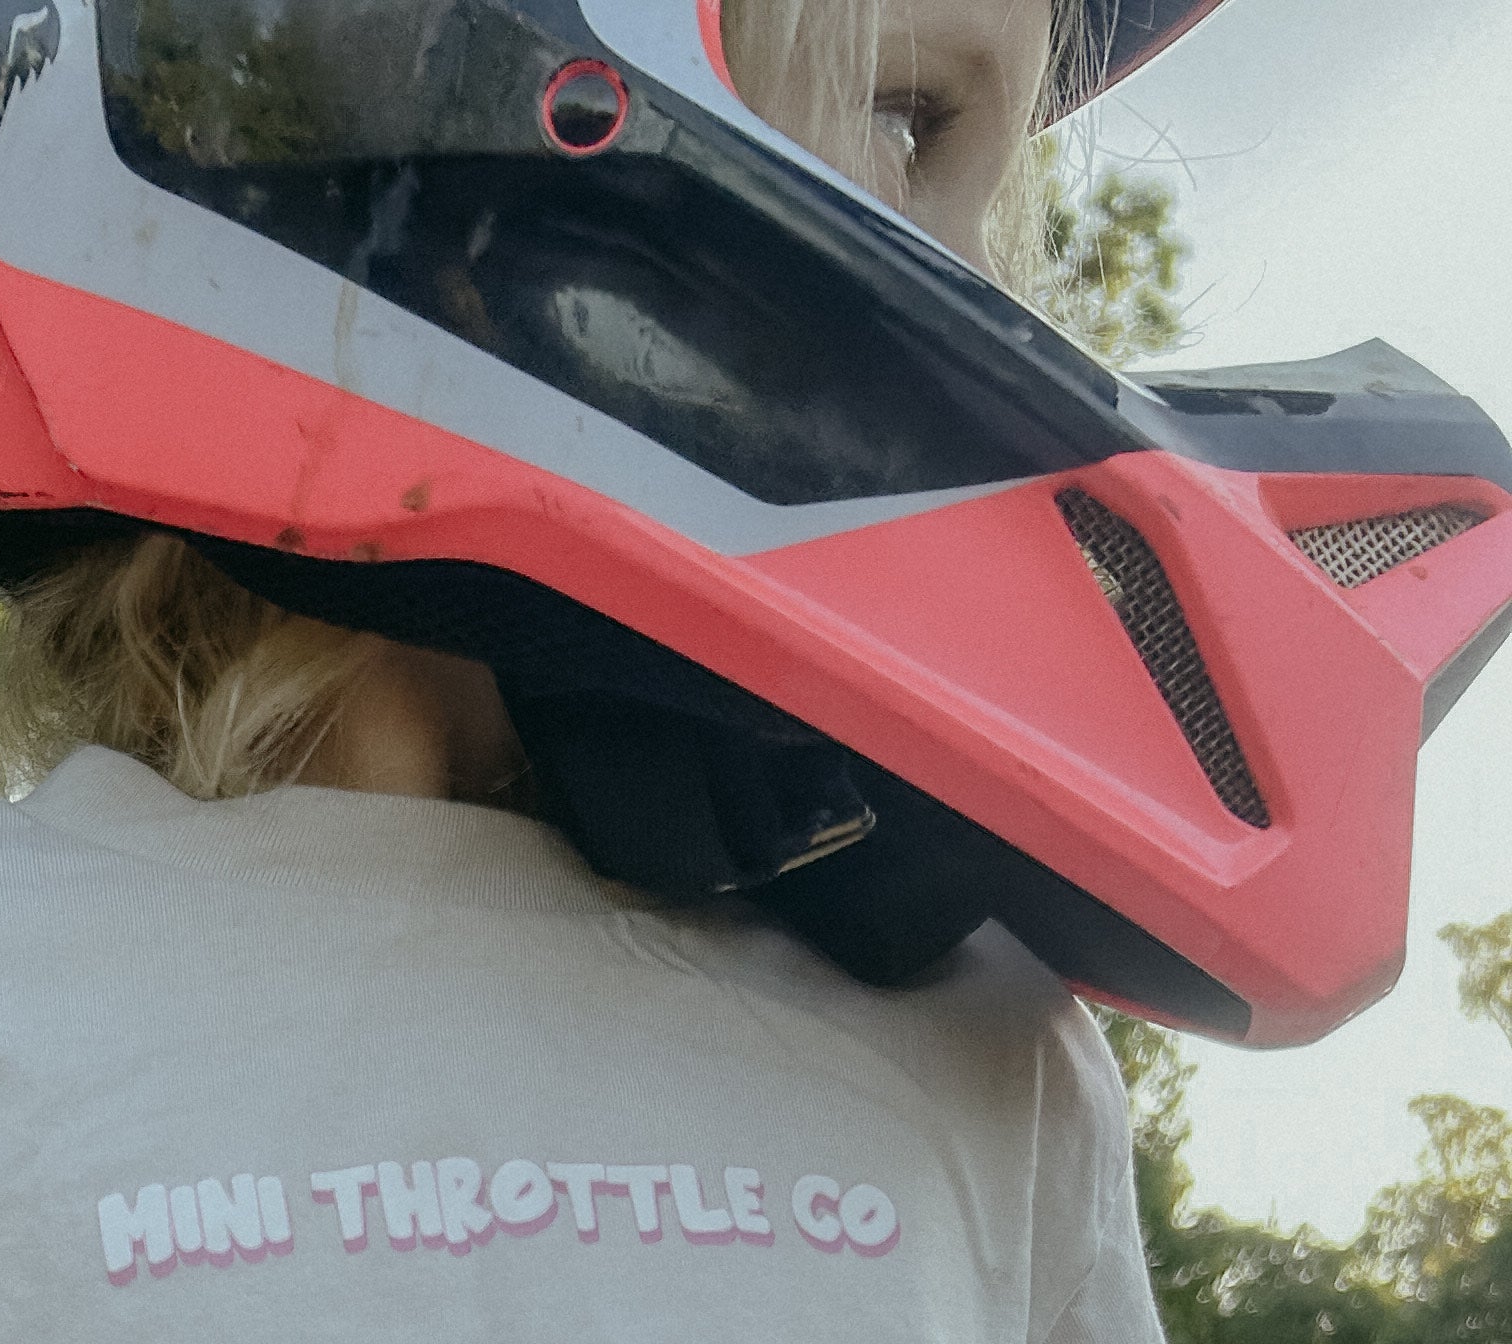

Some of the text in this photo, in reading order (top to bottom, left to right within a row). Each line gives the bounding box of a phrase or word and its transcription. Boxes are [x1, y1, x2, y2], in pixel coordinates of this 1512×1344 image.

[96, 1156, 902, 1287] MINI THROTTLE CO
